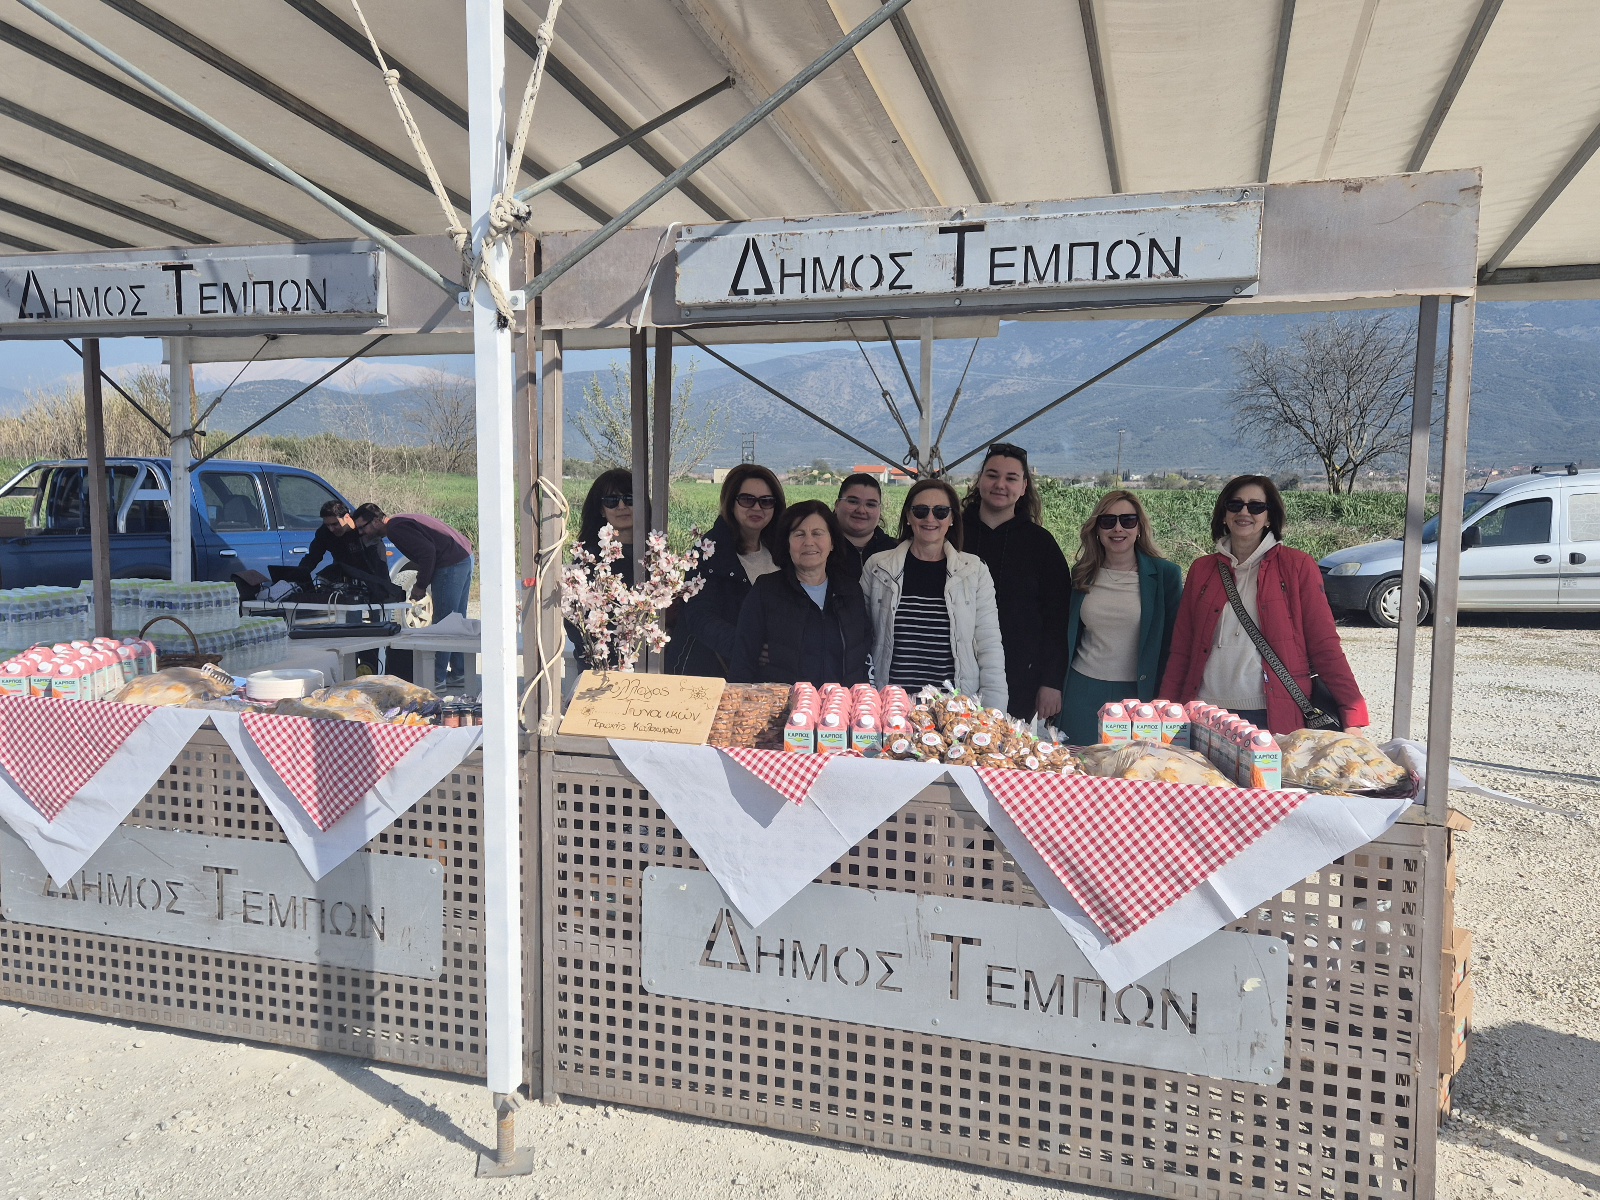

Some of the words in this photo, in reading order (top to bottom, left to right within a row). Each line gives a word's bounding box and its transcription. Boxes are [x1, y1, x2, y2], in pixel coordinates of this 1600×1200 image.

[18, 269, 148, 319] ΔΗΜΟΣ
[161, 263, 328, 315] ΤΕΜΠΩΝ
[727, 237, 913, 296] ΔΗΜΟΣ
[938, 224, 1182, 287] ΤΕΜΠΩΝ
[202, 864, 387, 943] ΤΕΜΠΩΝ
[699, 907, 903, 993] ΔΗΜΟΣ
[930, 933, 1199, 1036] ΤΕΜΠΩΝ
